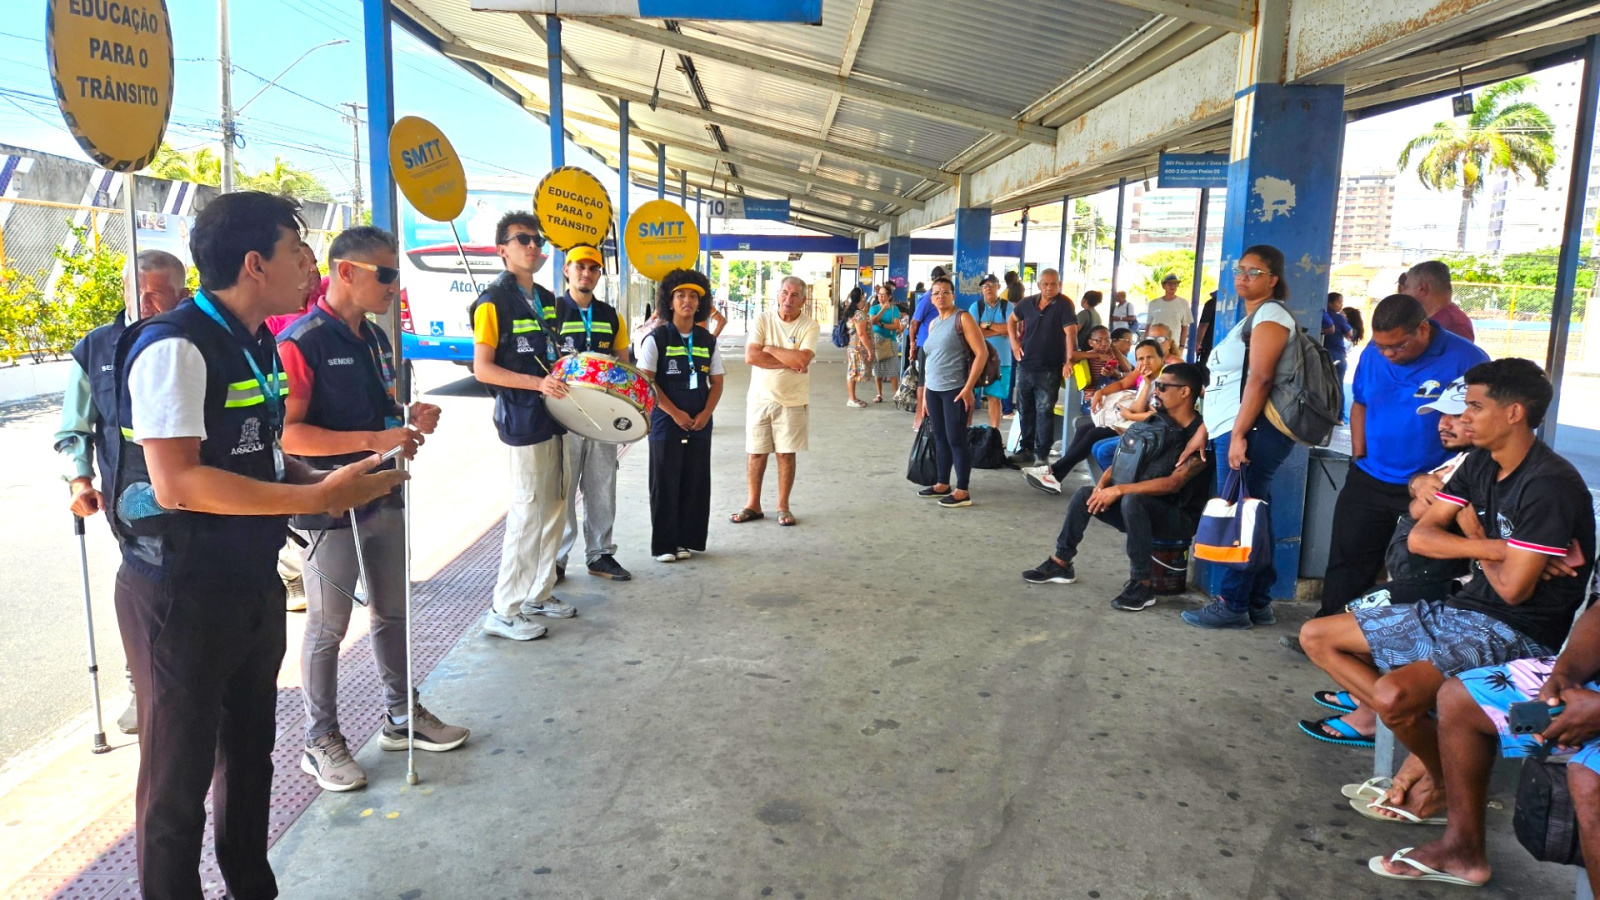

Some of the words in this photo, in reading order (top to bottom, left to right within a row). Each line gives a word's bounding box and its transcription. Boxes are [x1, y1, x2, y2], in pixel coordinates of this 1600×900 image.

[69, 0, 158, 34] EDUCAÇÃO
[89, 37, 135, 66] PARA
[139, 48, 148, 68] O
[76, 75, 158, 107] TRÂNSITO
[401, 138, 442, 169] SMTT
[548, 186, 603, 209] EDUCAÇÃO
[707, 200, 725, 216] 10
[556, 202, 583, 217] PARA
[586, 211, 593, 220] O
[547, 214, 597, 236] TRÂNSITO
[638, 221, 684, 238] SMTT
